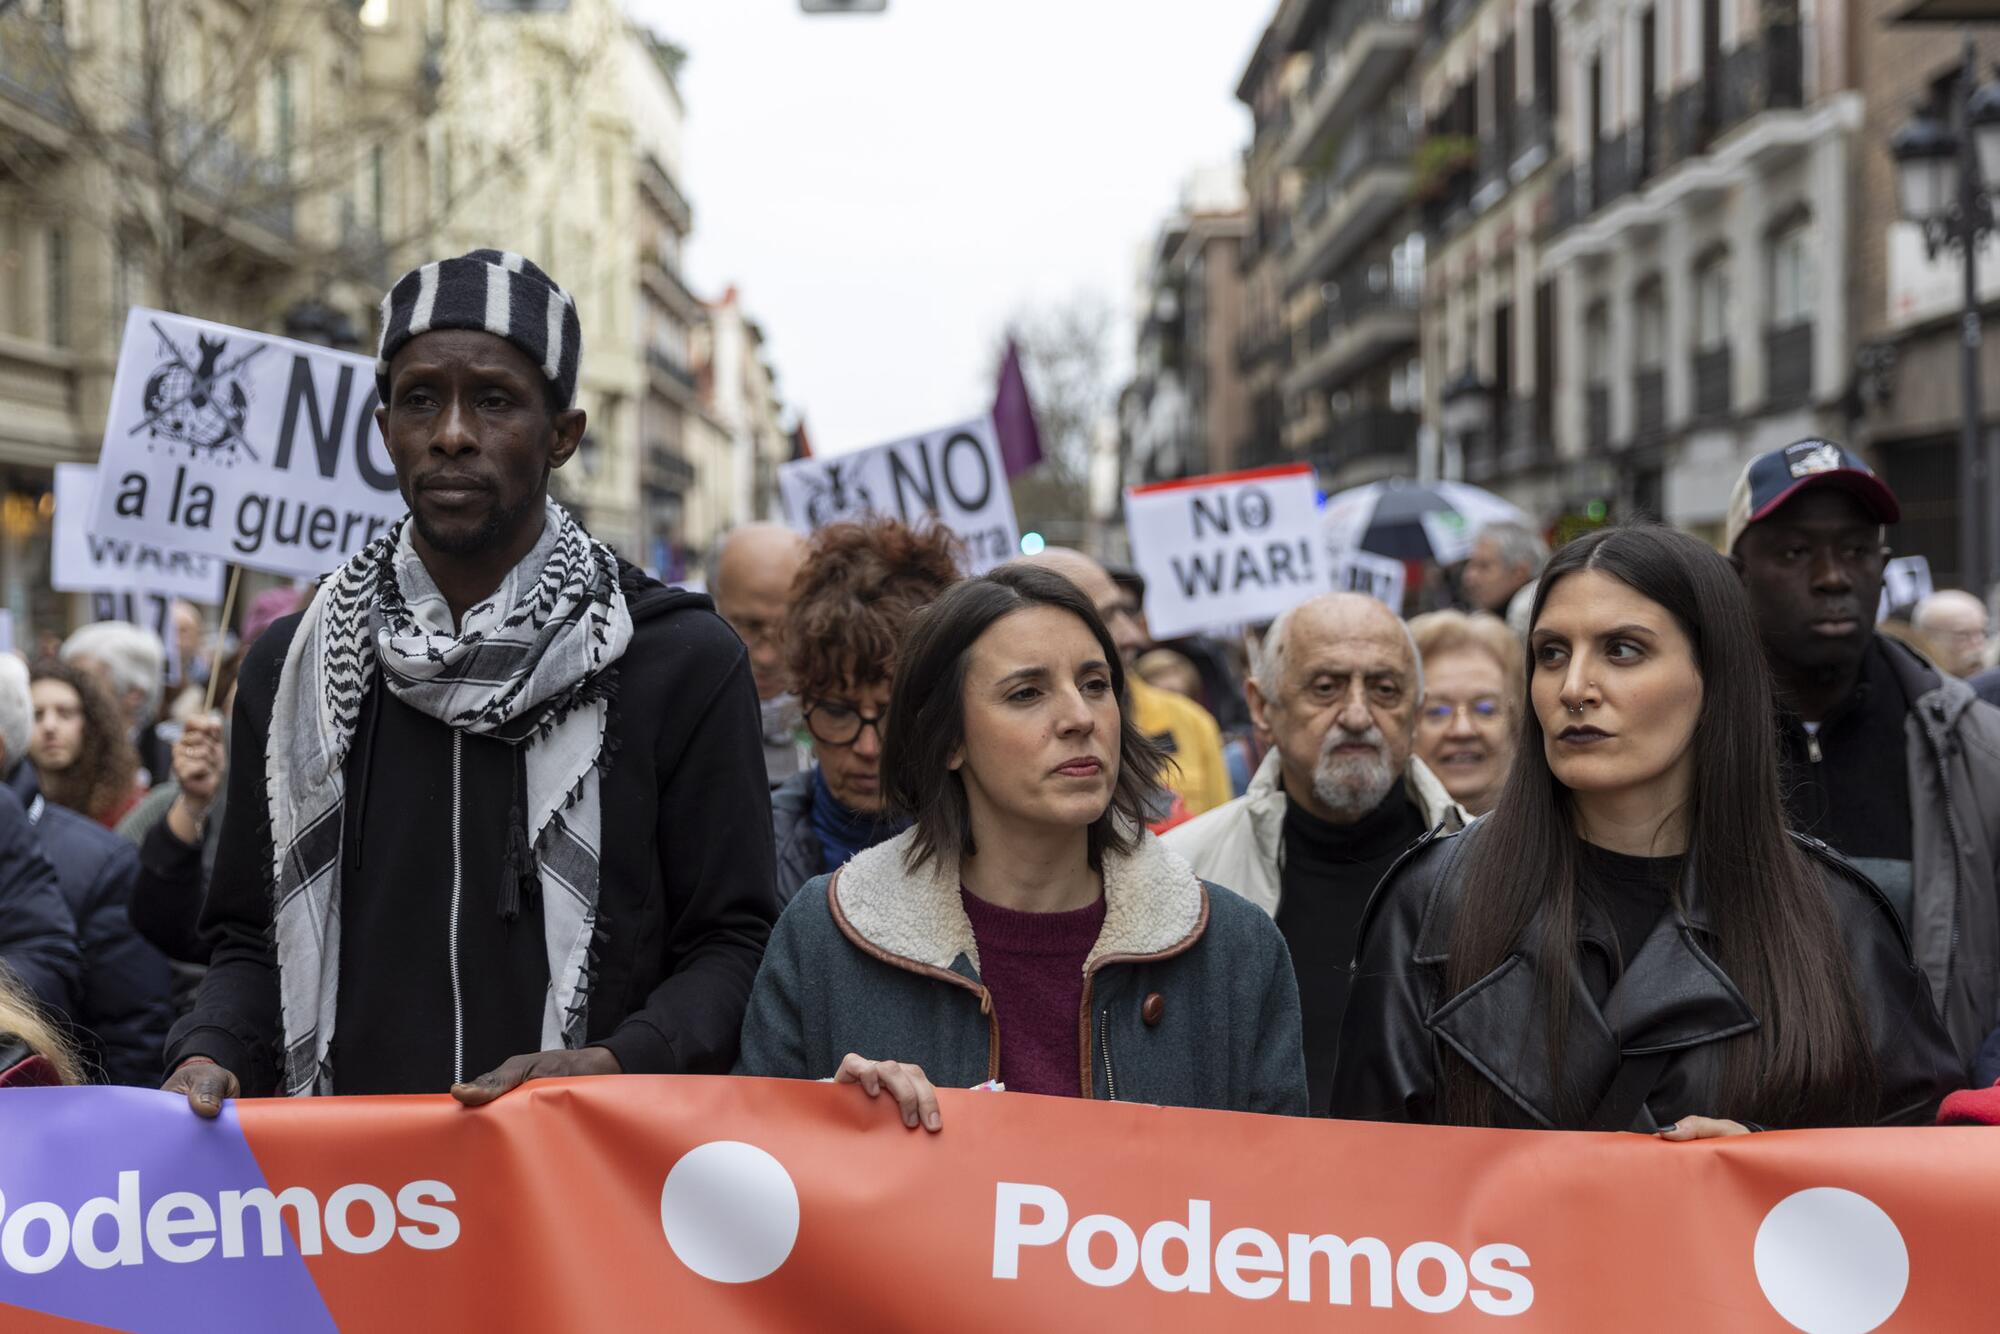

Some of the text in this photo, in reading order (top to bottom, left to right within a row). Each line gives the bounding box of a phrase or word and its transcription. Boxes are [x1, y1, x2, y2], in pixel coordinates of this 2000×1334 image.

[115, 466, 386, 554] a la guerr
[888, 432, 991, 523] NO
[1190, 486, 1273, 539] NO
[1171, 540, 1315, 598] WAR!
[0, 1170, 461, 1275] odemos
[992, 1181, 1535, 1317] Podemos
